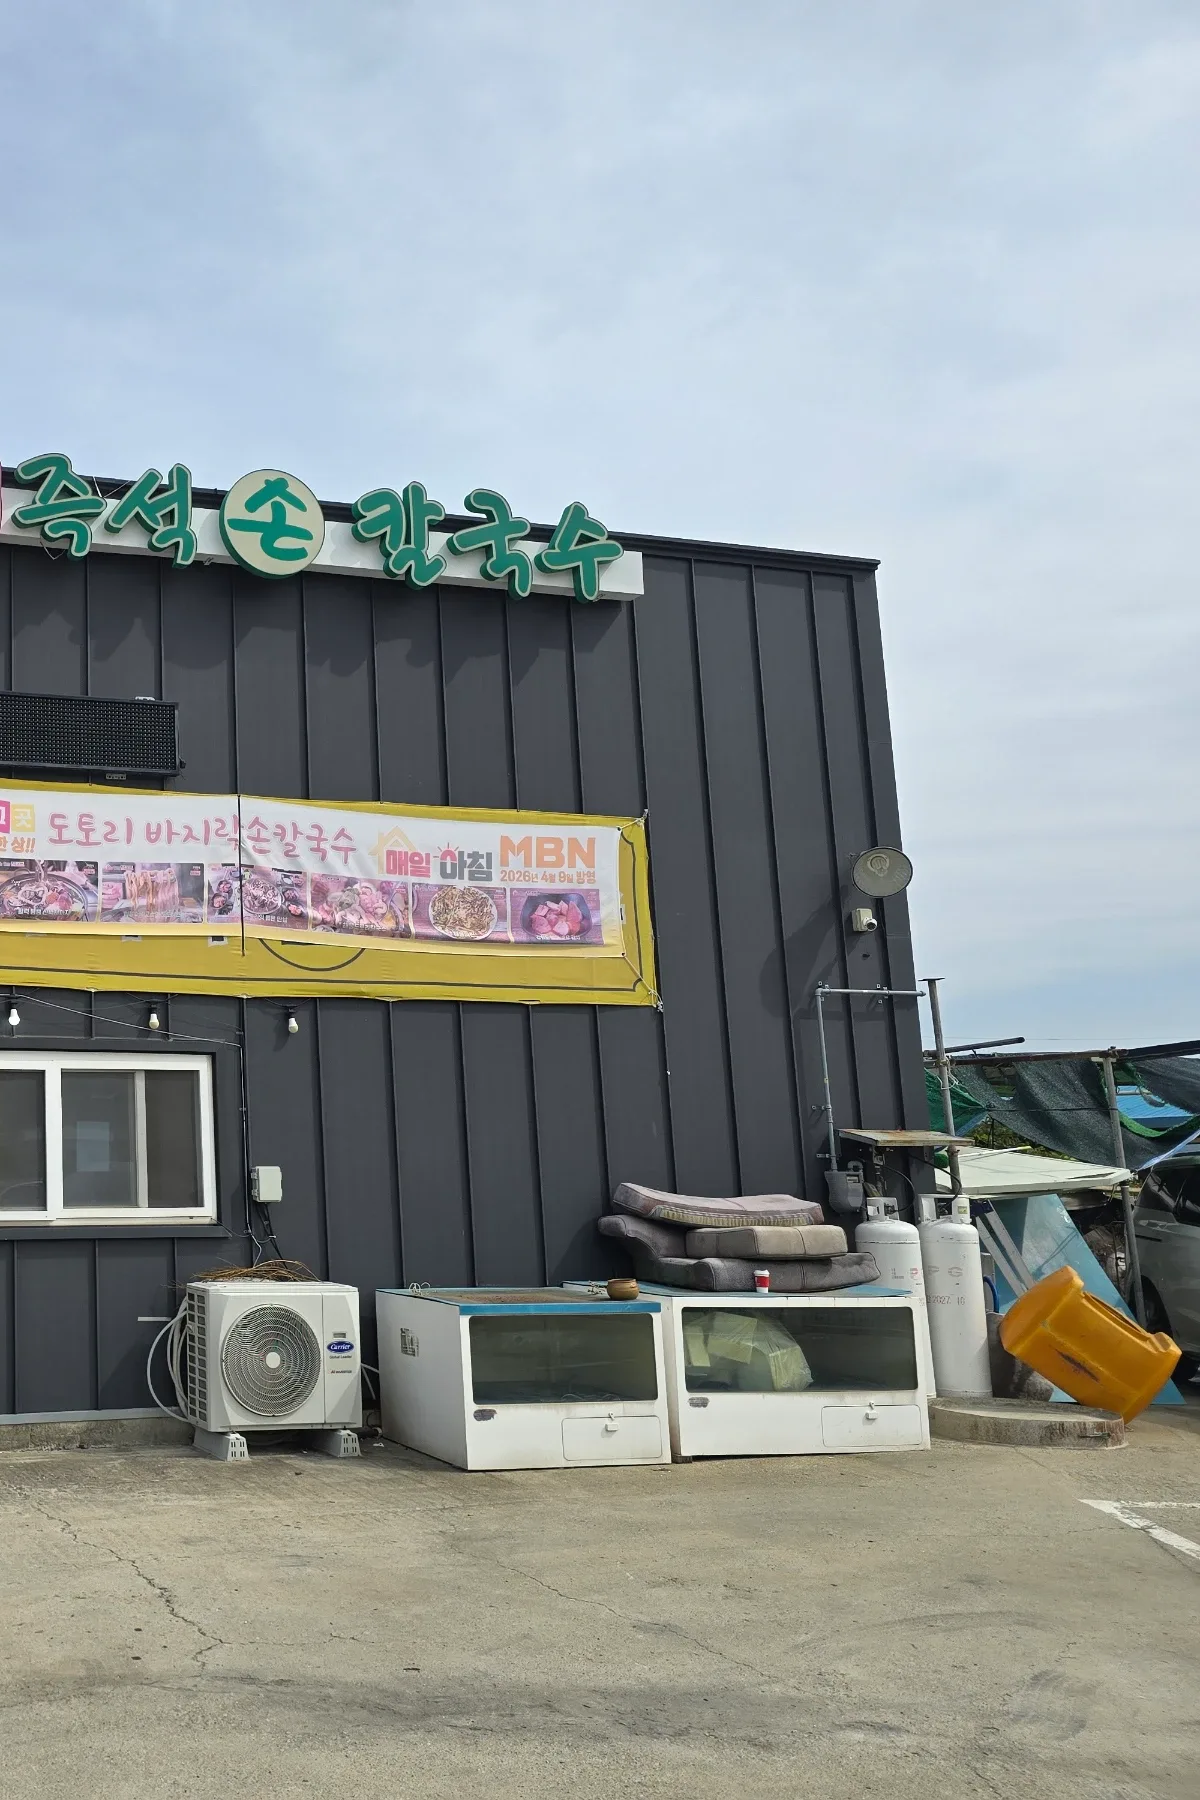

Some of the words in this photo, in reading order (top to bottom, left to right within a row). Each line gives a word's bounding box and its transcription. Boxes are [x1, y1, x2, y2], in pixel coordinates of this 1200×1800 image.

[351, 479, 625, 602] 칼국수
[47, 812, 134, 847] 도토리
[385, 849, 432, 879] 매일
[439, 846, 493, 882] 아침
[500, 834, 597, 869] MBN
[500, 869, 539, 883] 2026년
[540, 870, 556, 884] 4월
[576, 871, 596, 885] 방영
